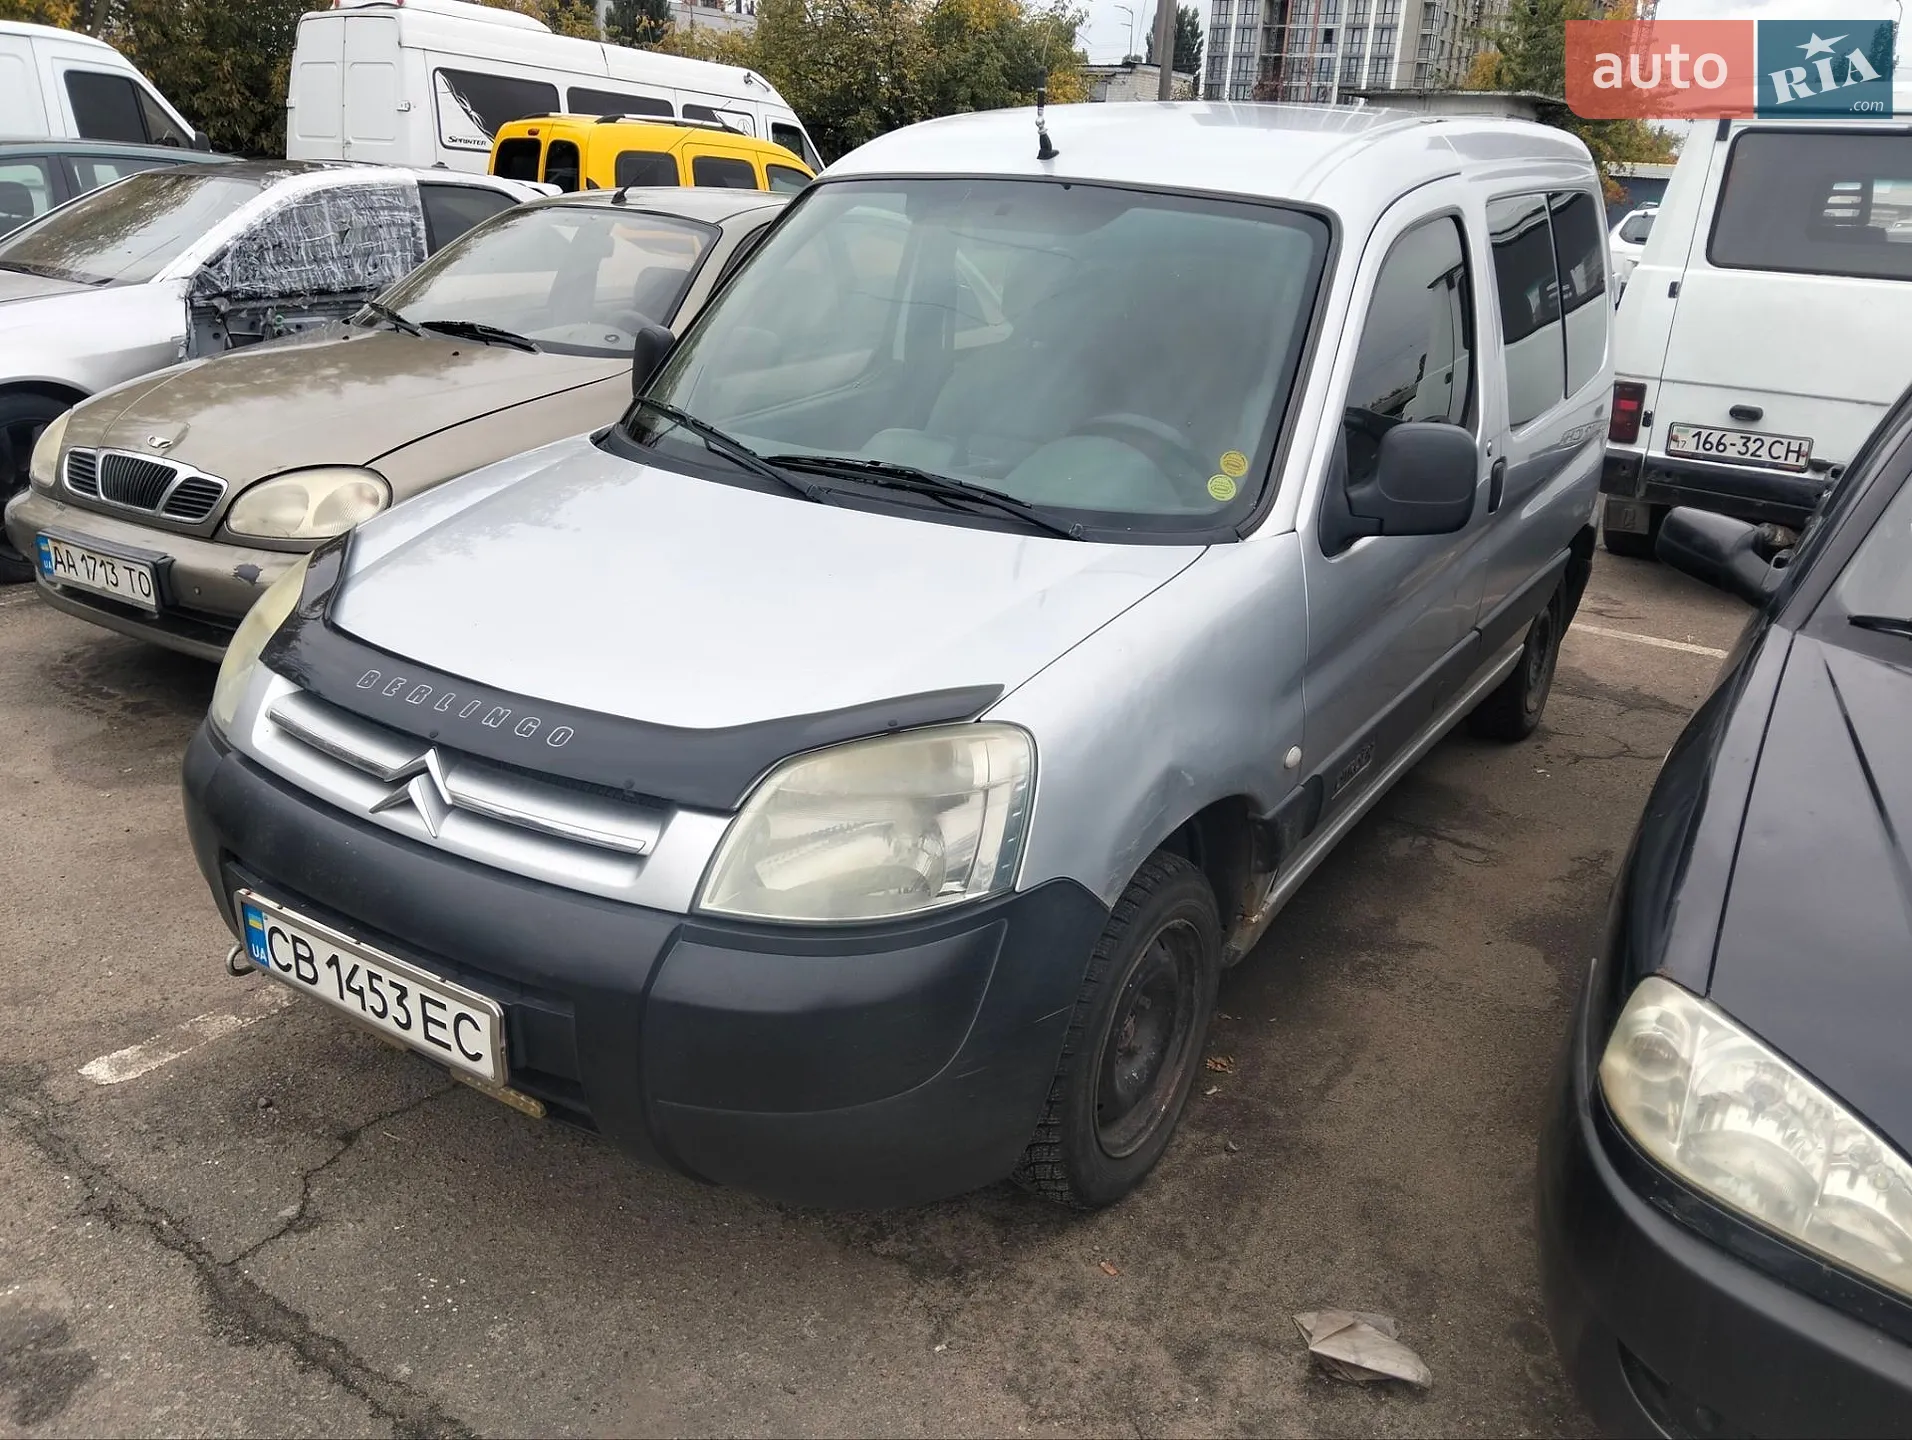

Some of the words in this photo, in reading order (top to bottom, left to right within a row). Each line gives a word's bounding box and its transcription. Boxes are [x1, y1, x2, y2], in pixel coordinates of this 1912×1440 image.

[1691, 430, 1765, 458] 166-32
[1768, 440, 1803, 463] CH
[53, 546, 79, 576] AA
[80, 553, 119, 588] 1713
[122, 565, 152, 598] TO
[356, 670, 574, 747] BERLINGO
[251, 943, 268, 962] UA
[267, 926, 319, 986] CB
[325, 953, 412, 1031] 1453
[419, 992, 483, 1062] EC
